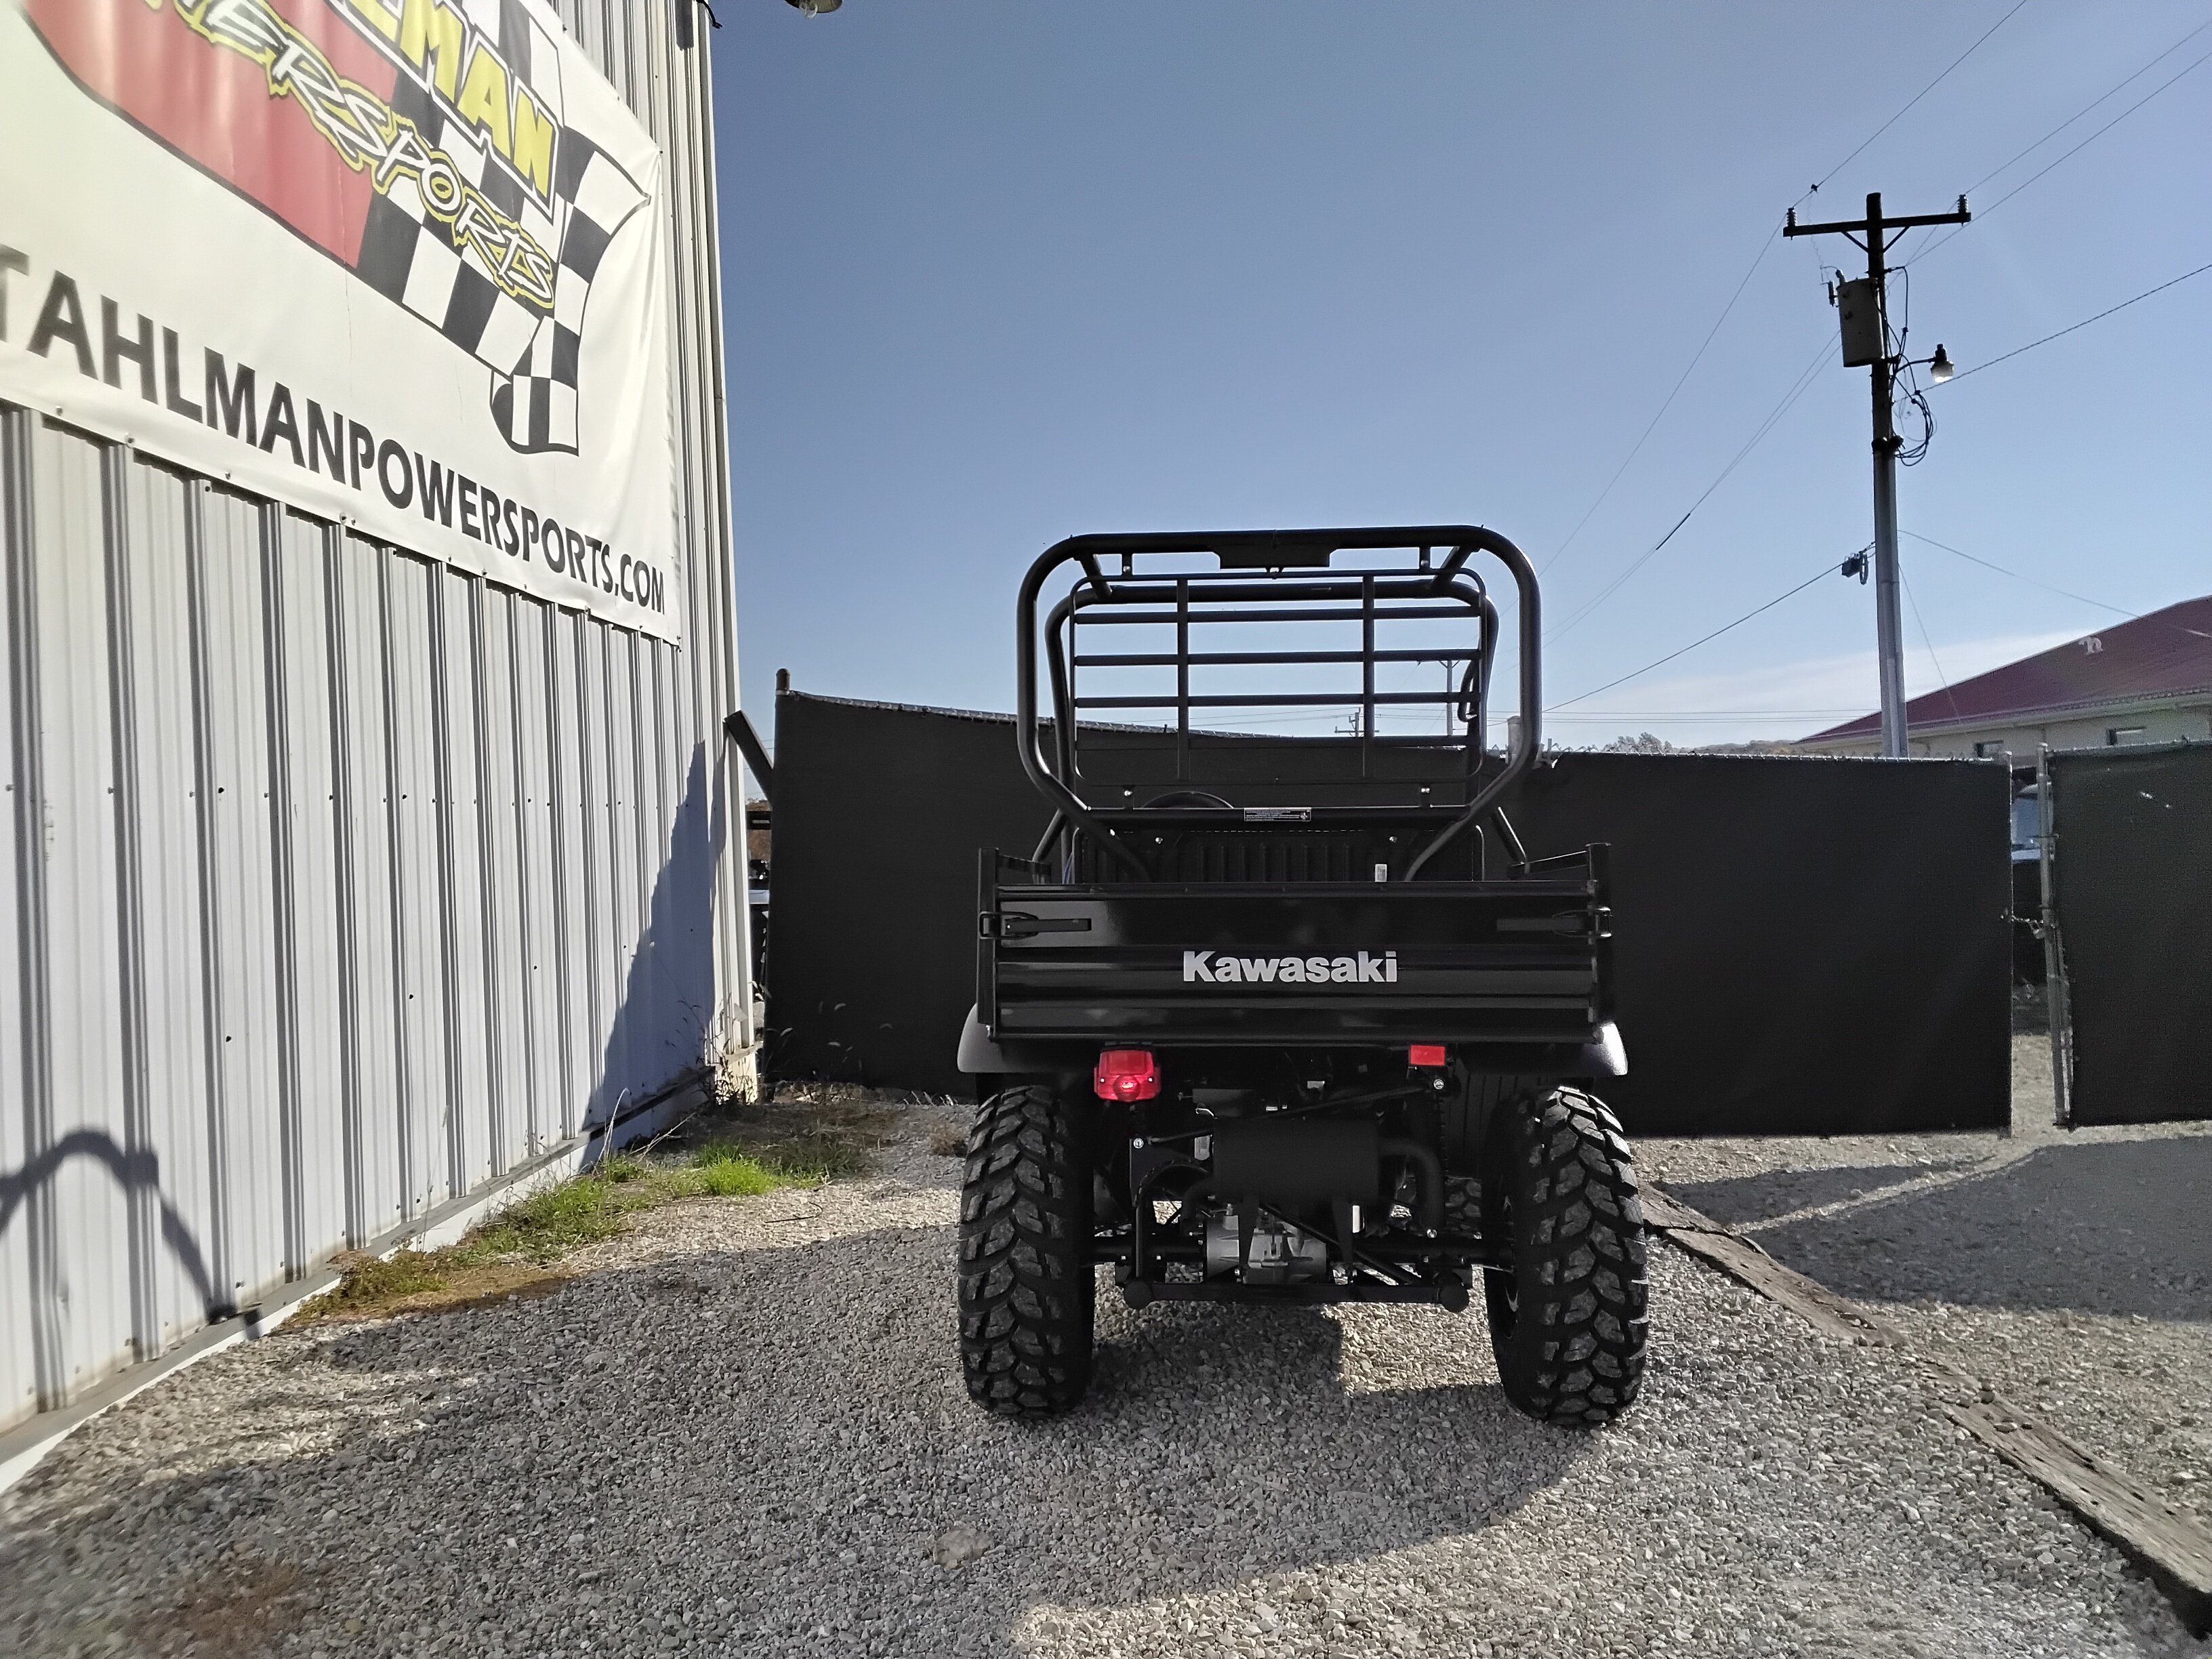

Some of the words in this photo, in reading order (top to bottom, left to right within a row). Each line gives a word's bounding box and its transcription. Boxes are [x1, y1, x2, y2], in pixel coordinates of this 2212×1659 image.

[182, 0, 554, 300] ERSPORTS
[347, 0, 554, 199] MAN
[1183, 950, 1397, 983] Kawasaki
